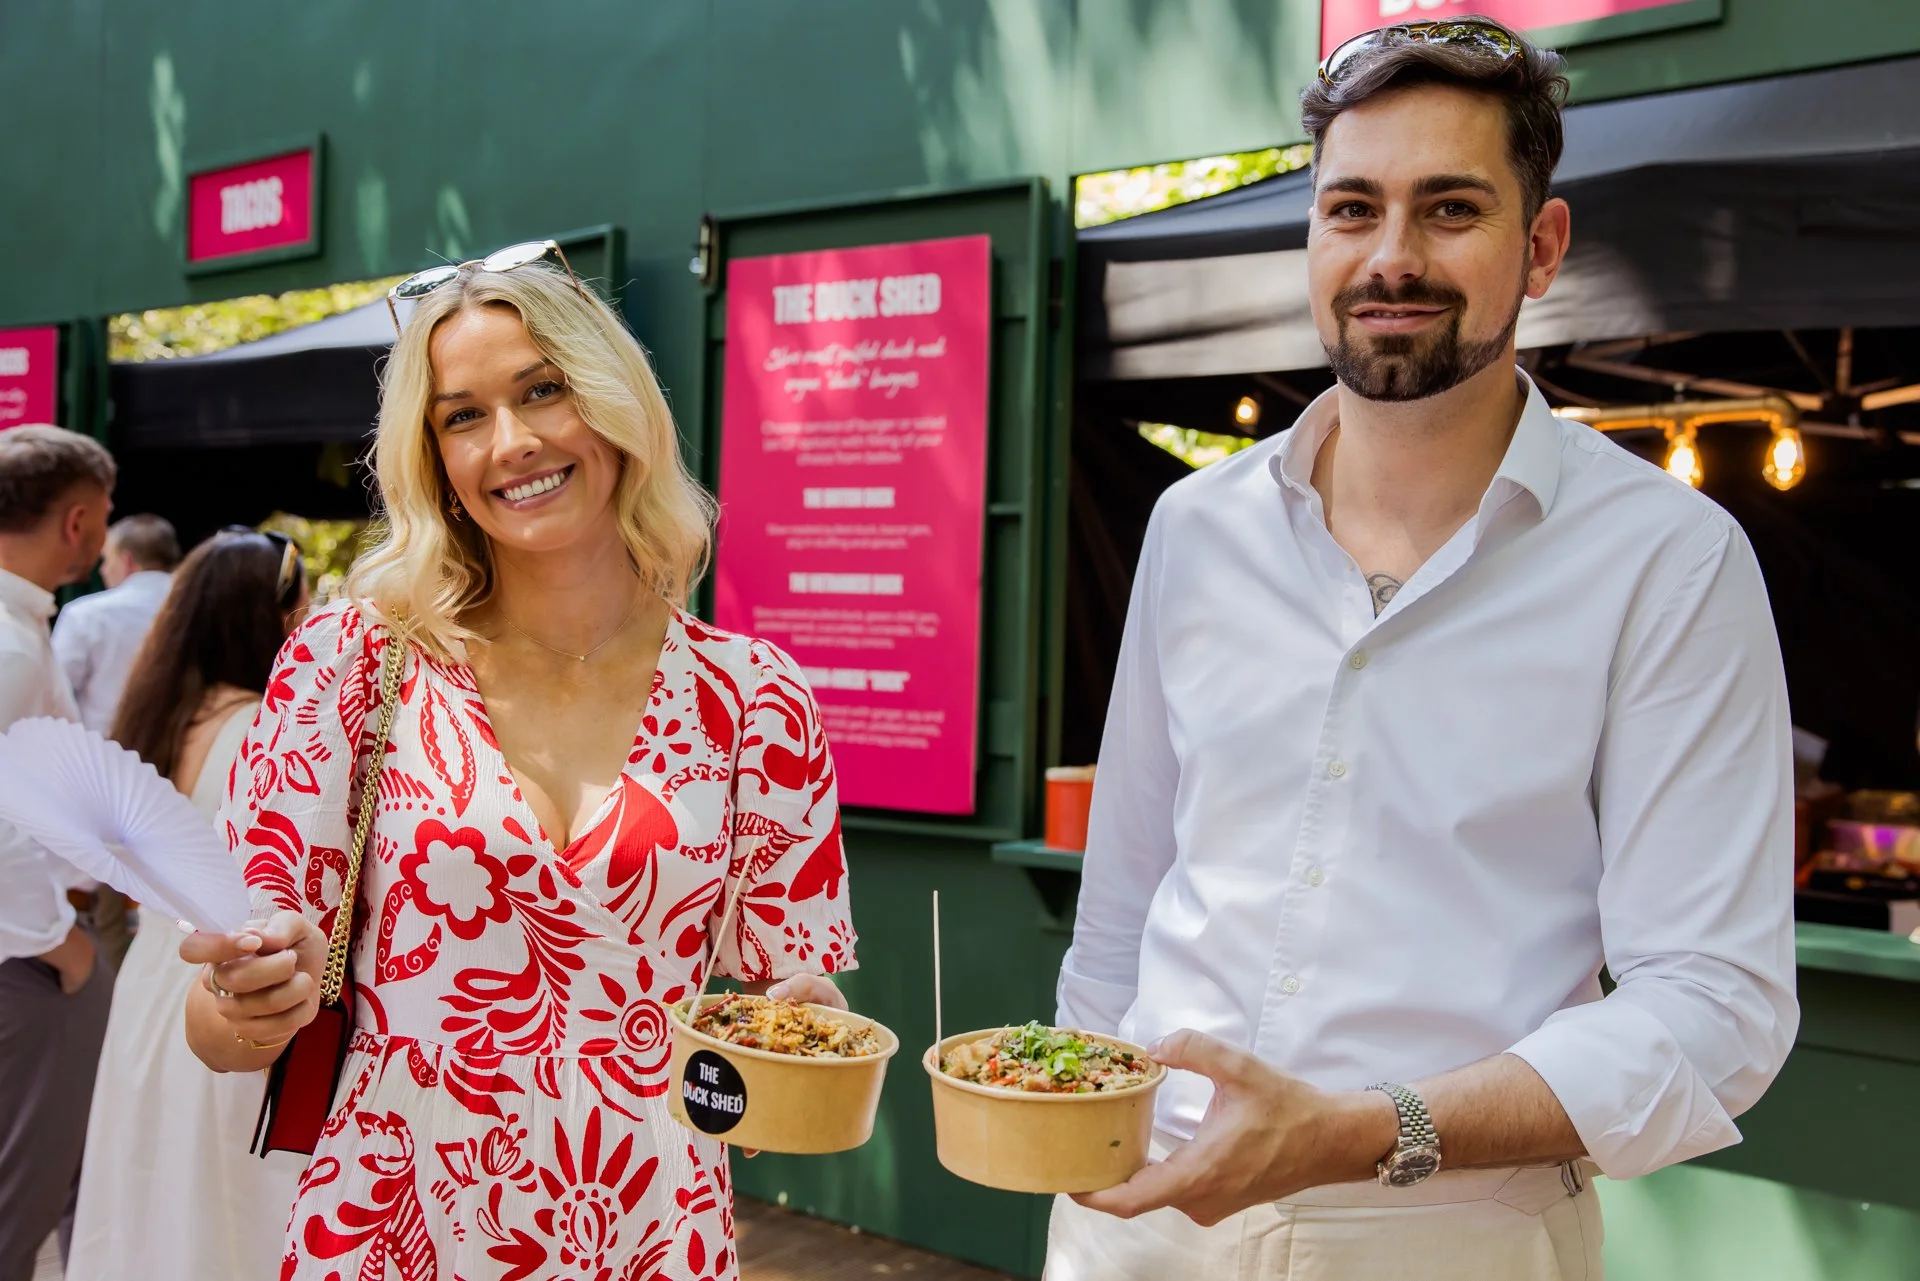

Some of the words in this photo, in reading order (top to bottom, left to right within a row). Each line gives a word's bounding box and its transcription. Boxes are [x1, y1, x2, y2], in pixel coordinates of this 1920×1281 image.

[221, 176, 283, 234] TACOS
[773, 284, 813, 324] THE
[814, 278, 878, 321] DUCK
[879, 273, 941, 317] SHED
[699, 1062, 720, 1085] THE
[683, 1080, 709, 1107] DUCK
[710, 1091, 744, 1114] SHED
